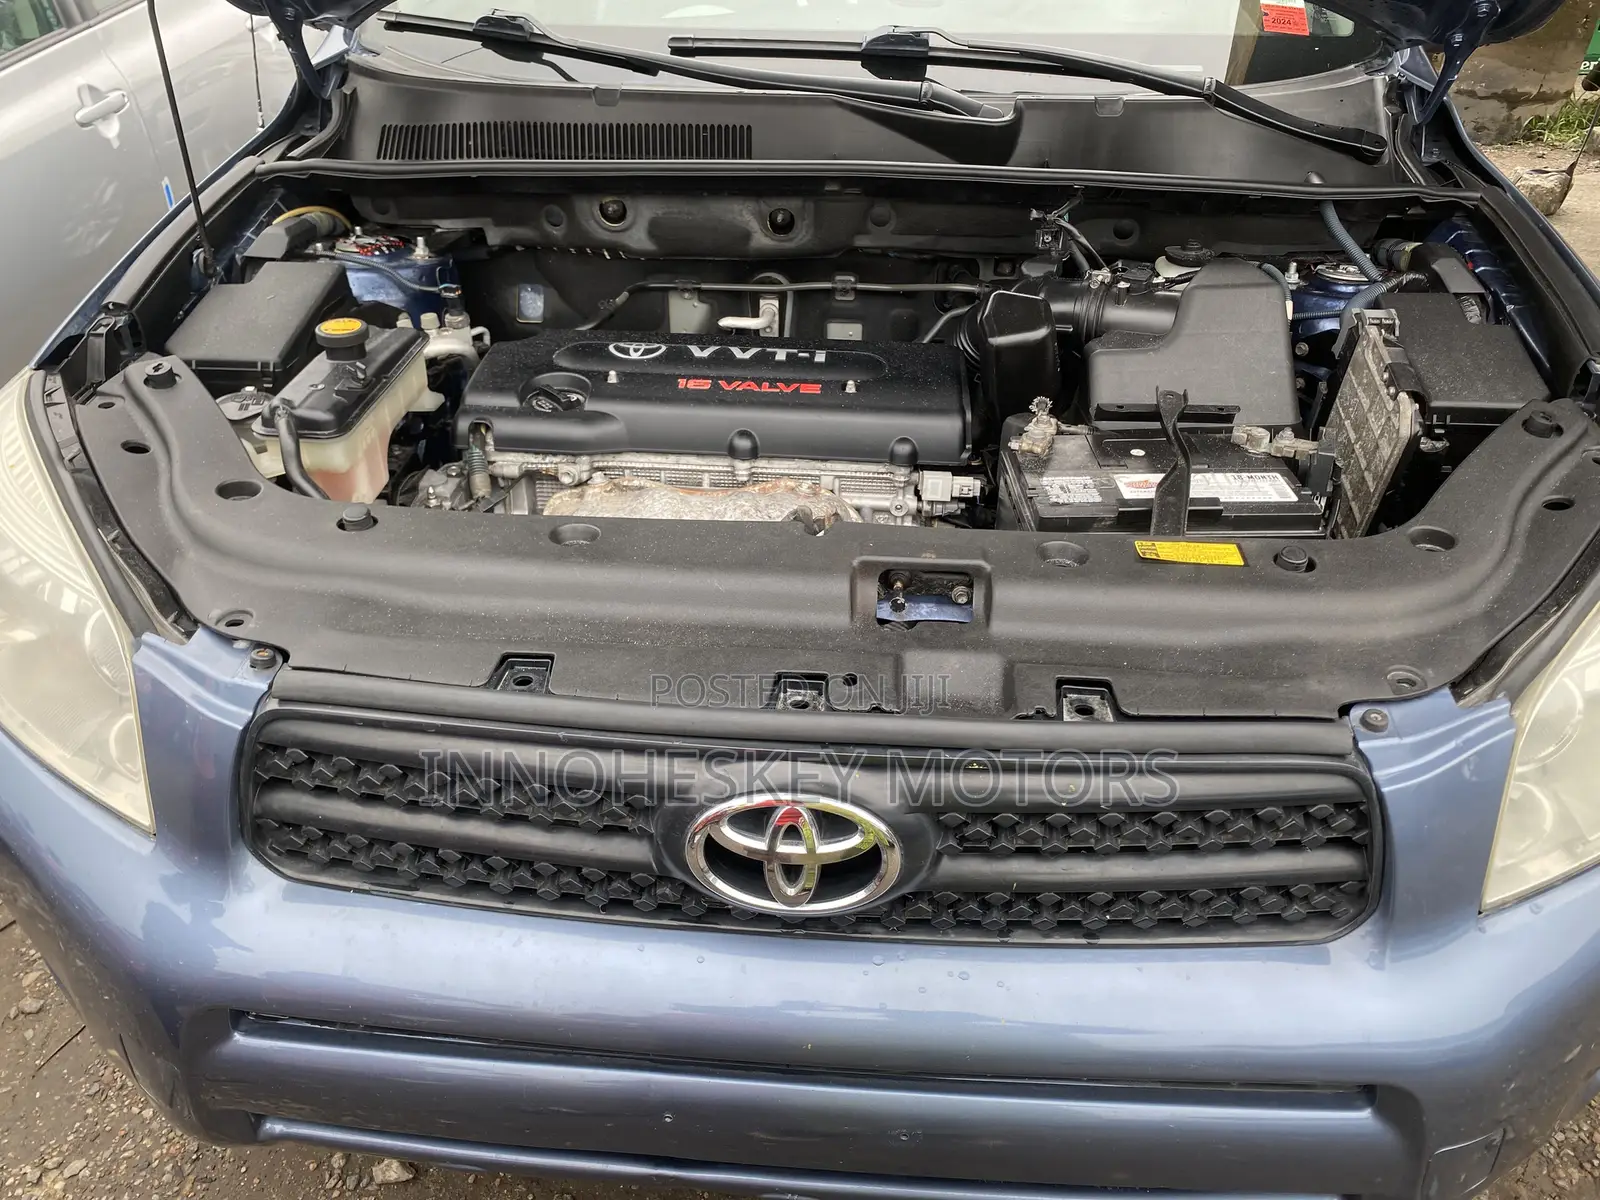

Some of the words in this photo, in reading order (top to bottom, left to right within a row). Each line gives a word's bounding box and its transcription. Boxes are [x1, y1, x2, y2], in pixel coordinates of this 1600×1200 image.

[1271, 17, 1292, 25] 2024
[677, 378, 712, 390] 16
[718, 380, 822, 394] VALVE
